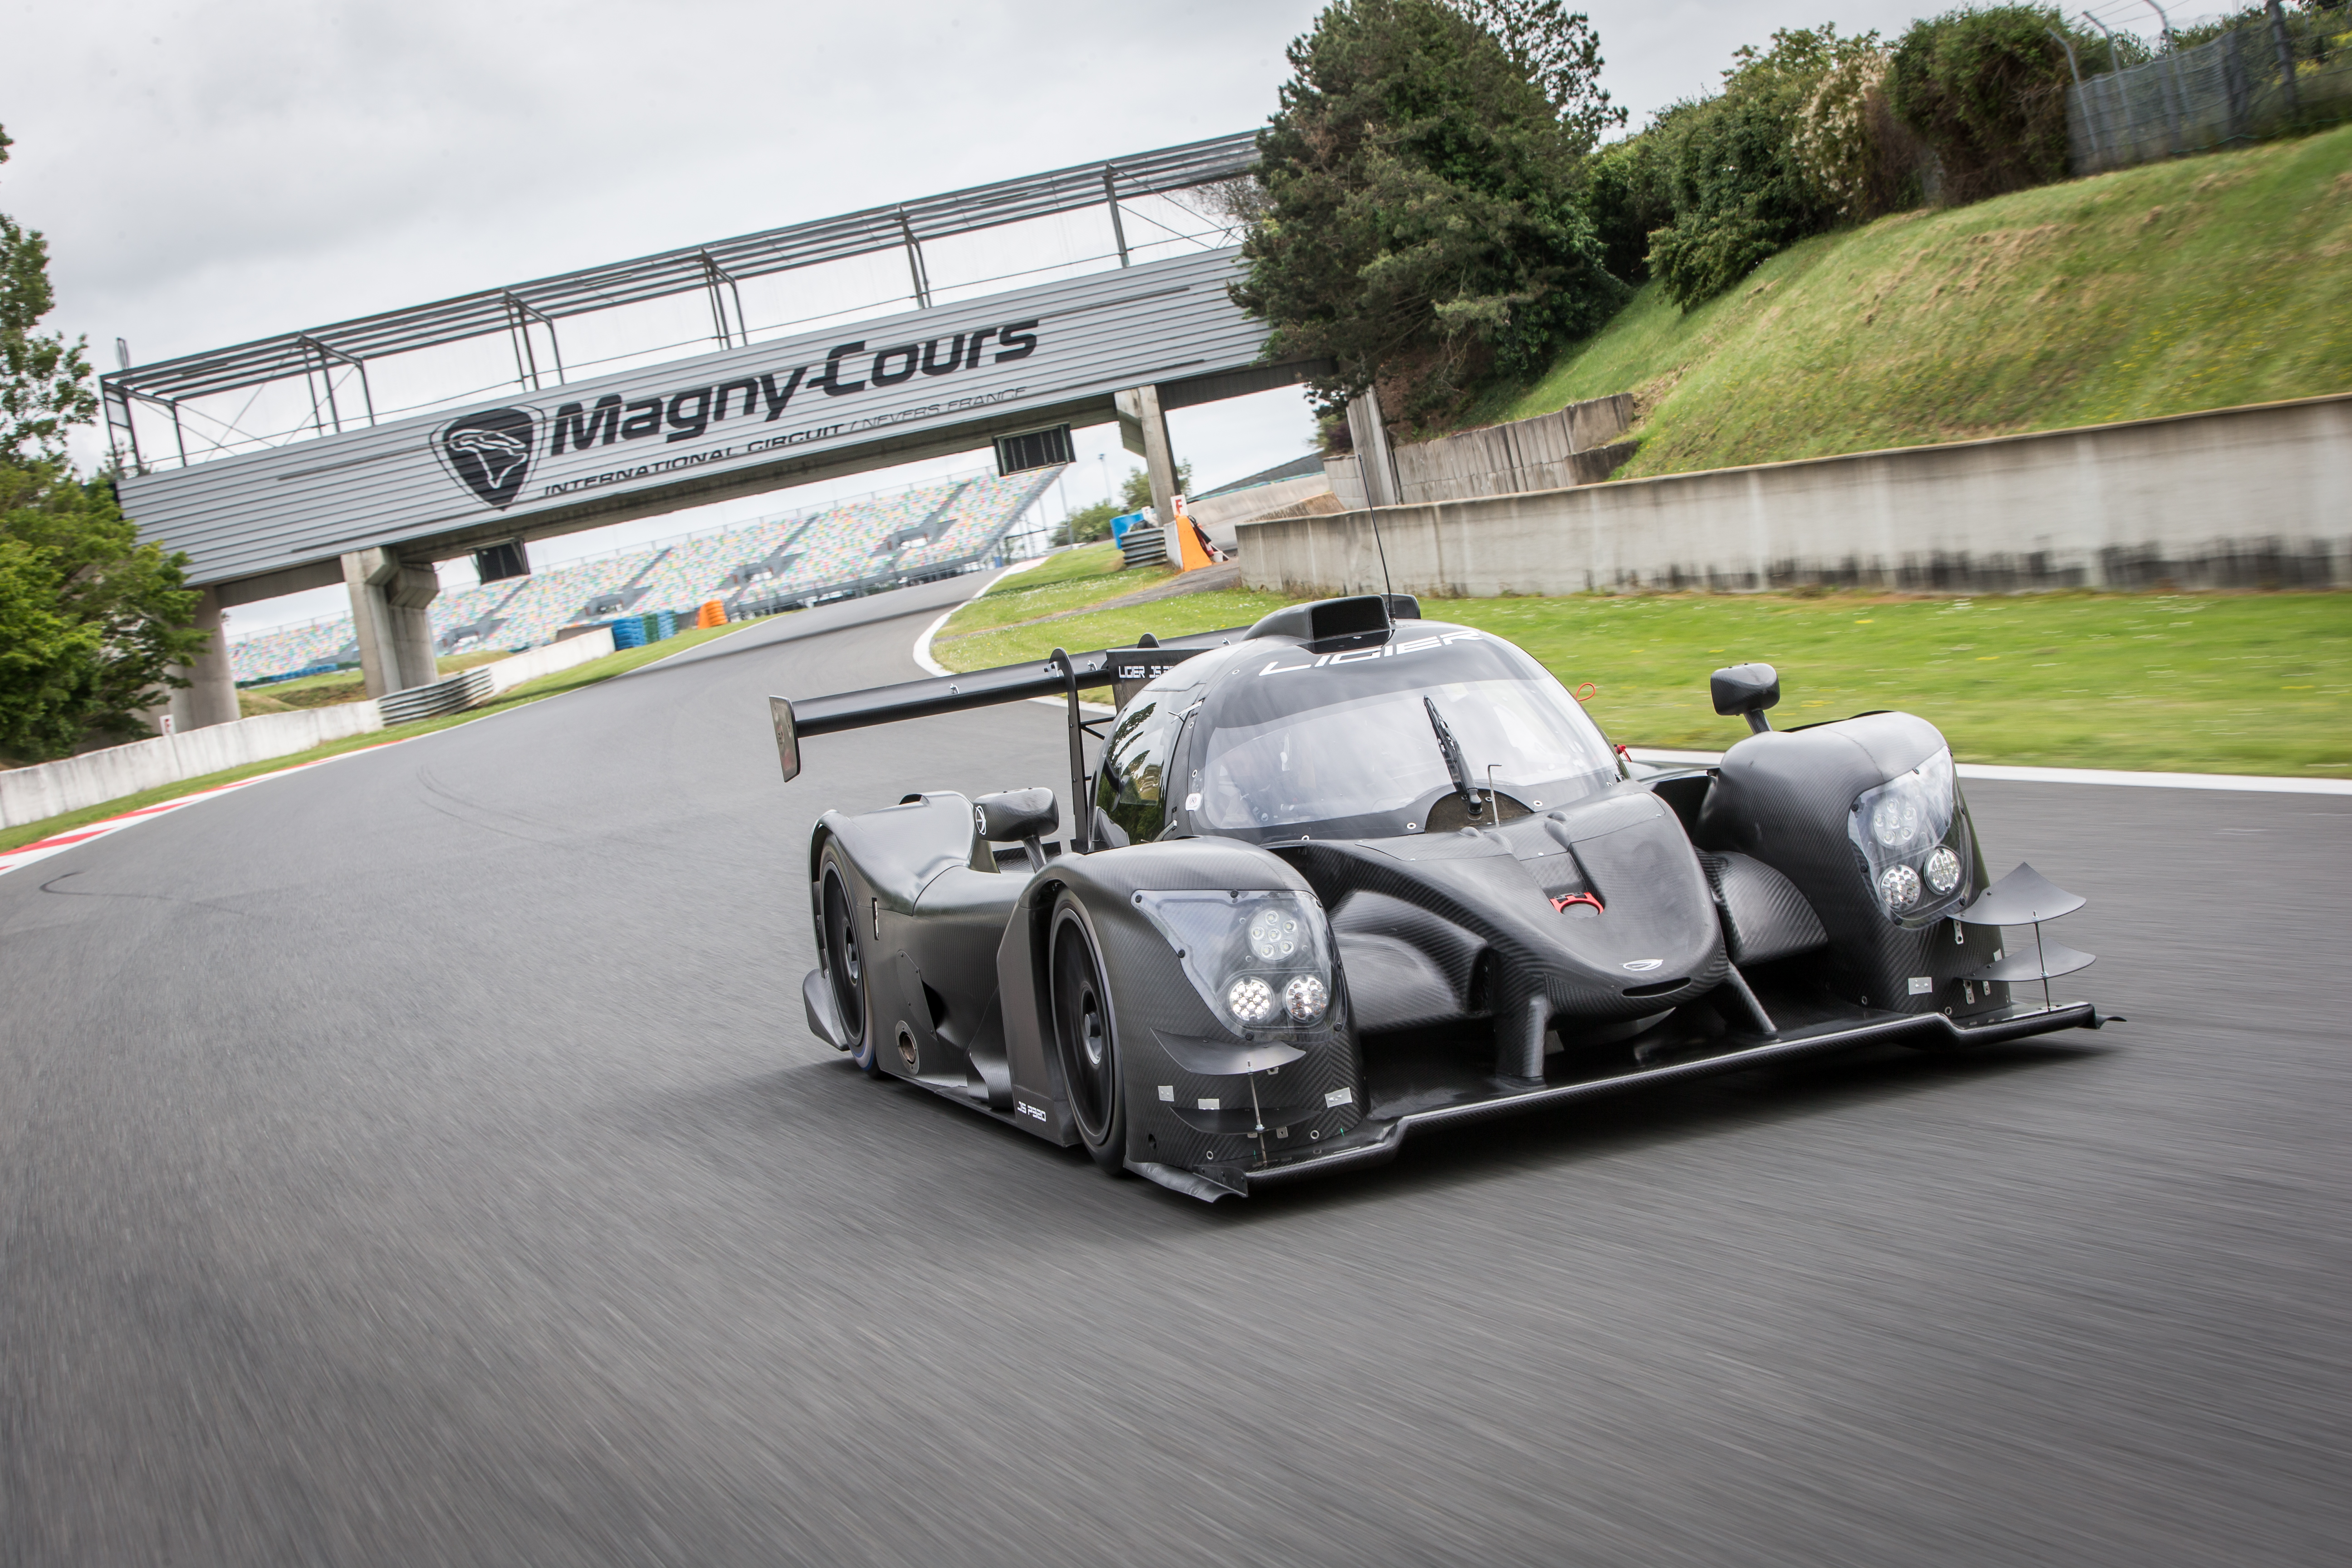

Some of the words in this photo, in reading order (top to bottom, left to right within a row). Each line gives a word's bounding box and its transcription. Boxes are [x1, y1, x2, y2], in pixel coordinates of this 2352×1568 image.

[550, 319, 1039, 456] Magny-Cours
[544, 446, 734, 496] INTERNATIONAL
[747, 423, 844, 453] CIRCUIT
[862, 403, 941, 428] NEVERS
[947, 386, 1028, 411] FRANCE
[1175, 499, 1183, 514] F
[1258, 630, 1484, 676] LIGIER
[1118, 666, 1146, 678] LIGIER
[1149, 666, 1161, 678] JS
[1017, 1101, 1027, 1114] JS
[1027, 1105, 1046, 1122] P320
